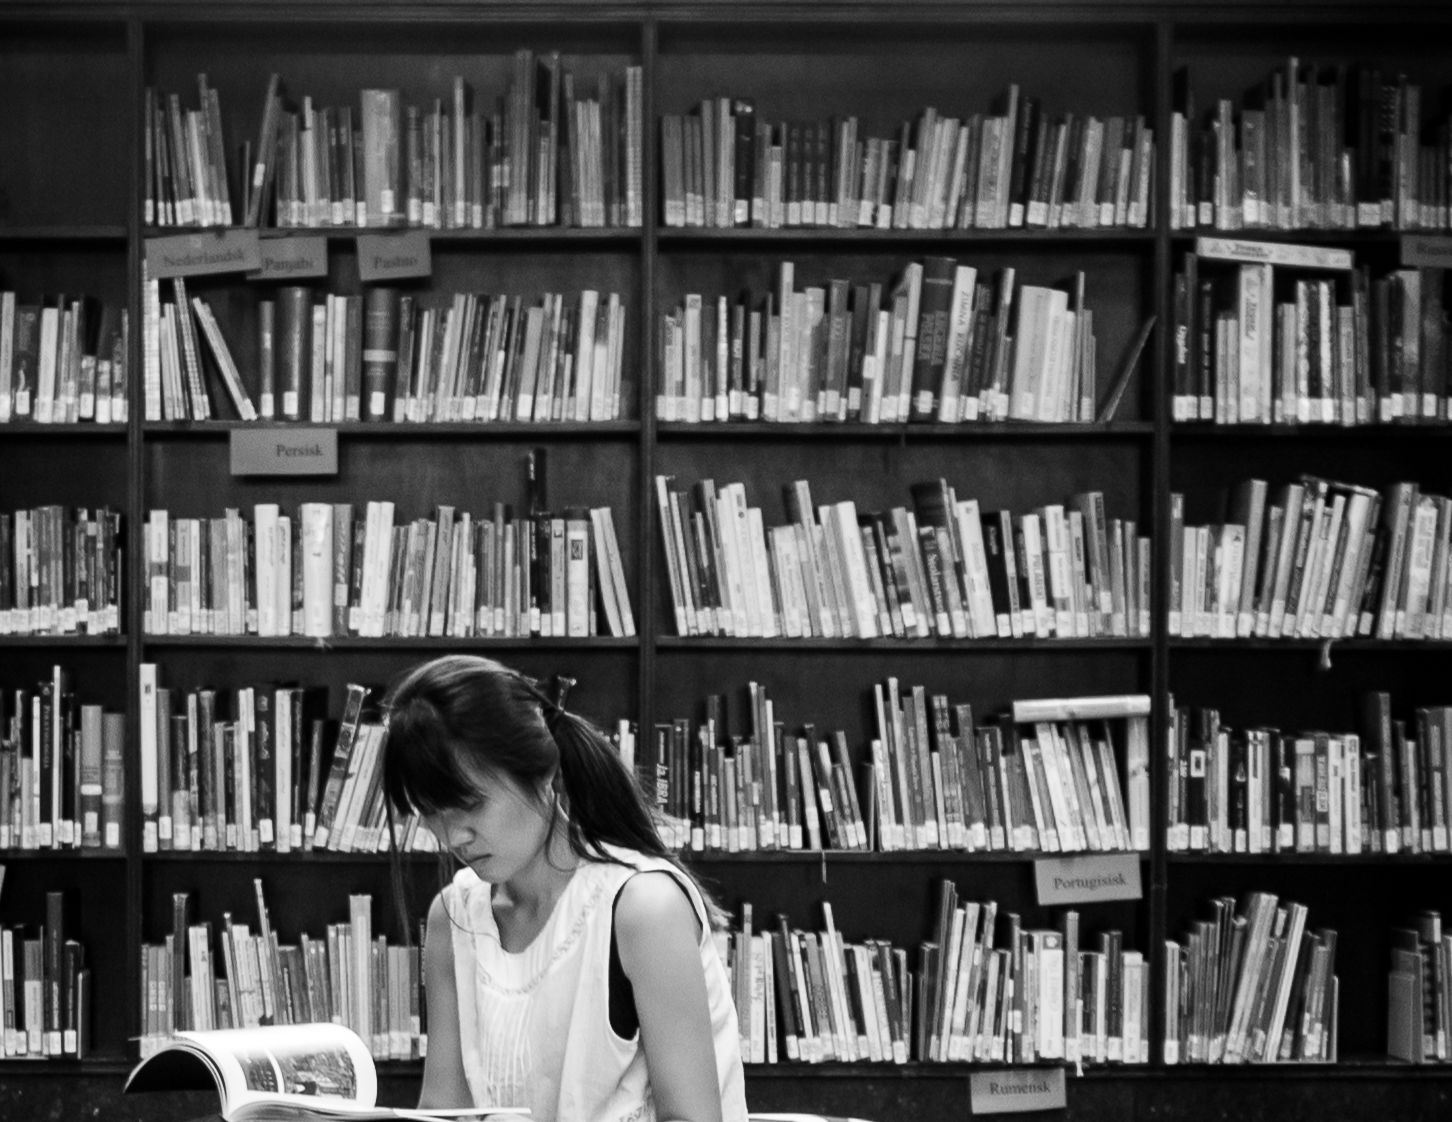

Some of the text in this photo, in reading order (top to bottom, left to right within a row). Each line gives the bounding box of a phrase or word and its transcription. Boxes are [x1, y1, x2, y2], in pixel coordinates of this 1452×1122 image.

[276, 442, 324, 458] Persisk
[1053, 873, 1128, 893] Portugisisk
[989, 1081, 1052, 1096] Rumensk
